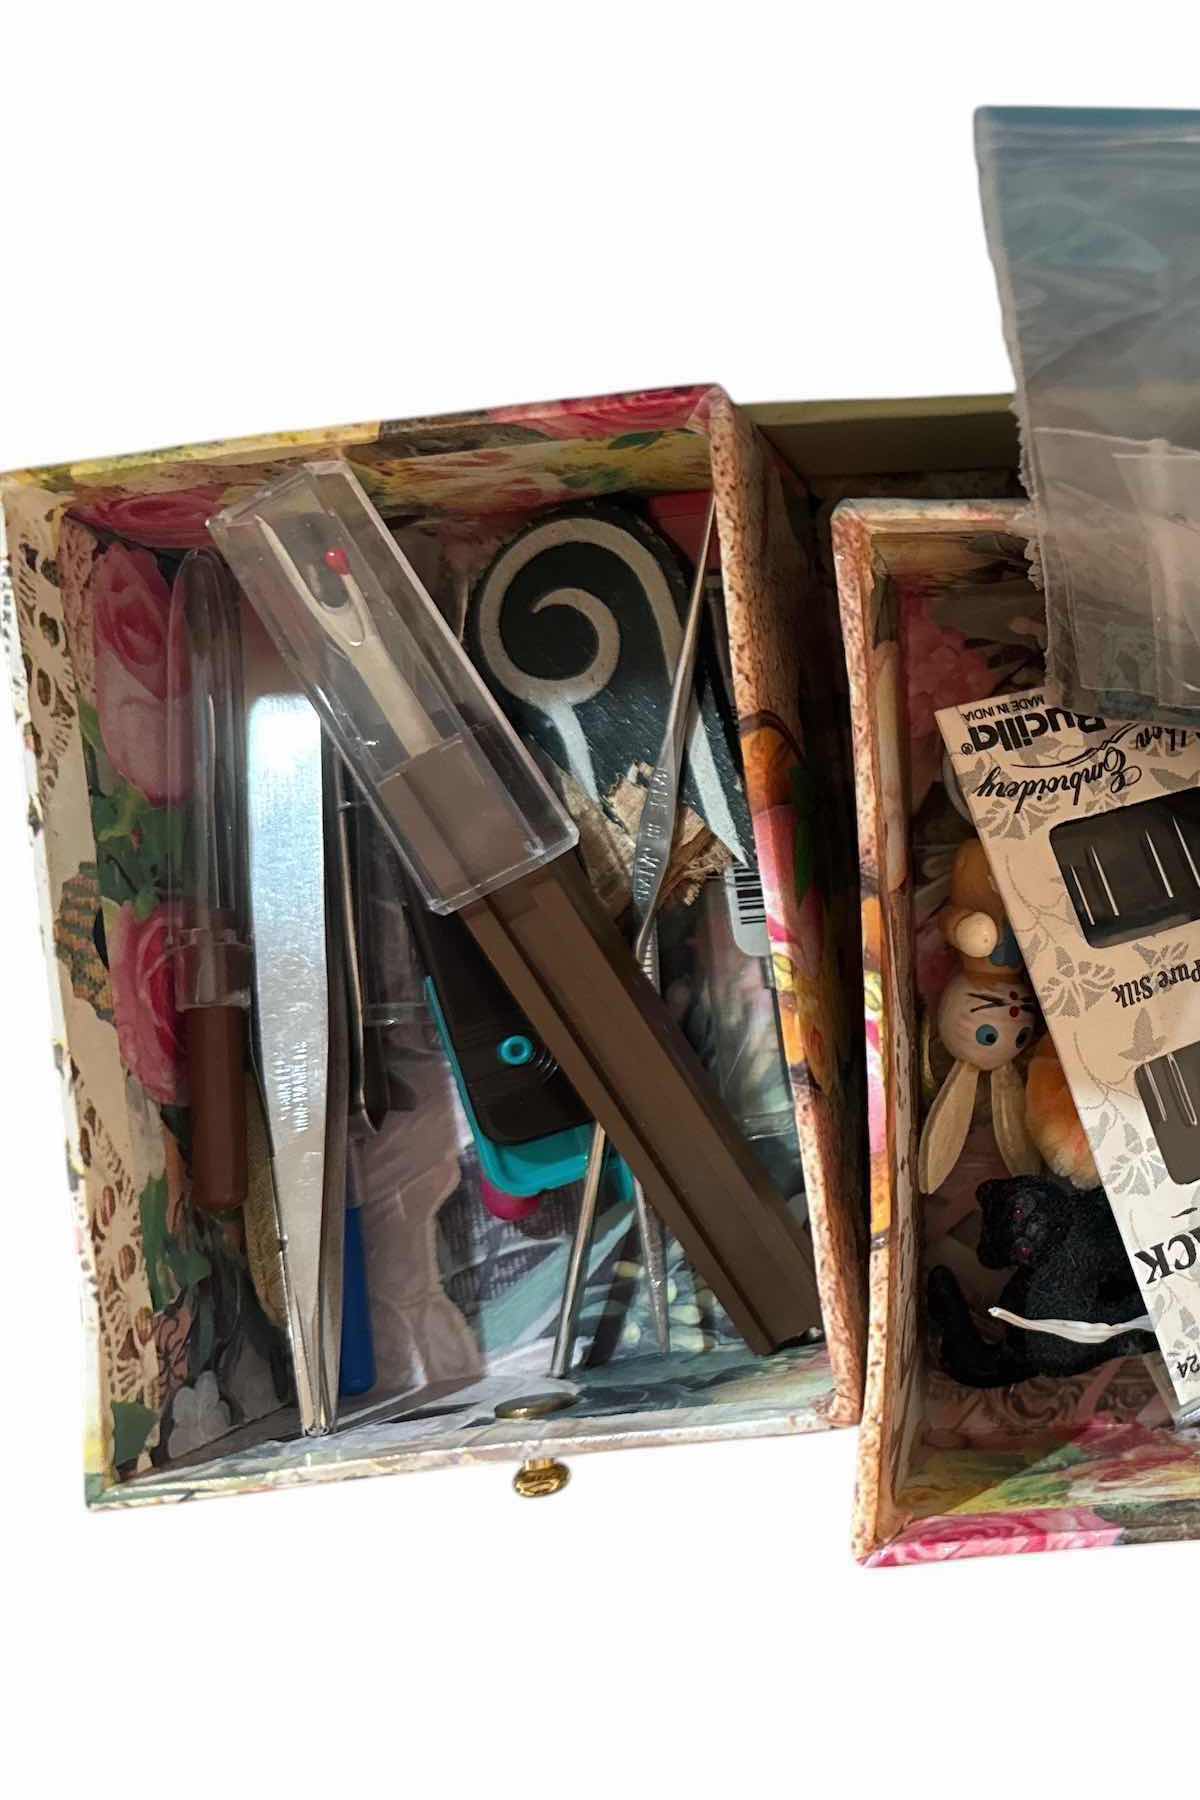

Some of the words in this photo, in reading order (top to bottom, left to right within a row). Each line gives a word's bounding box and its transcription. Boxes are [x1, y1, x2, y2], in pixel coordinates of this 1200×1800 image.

[995, 703, 1011, 715] IN
[1013, 691, 1046, 712] MADE
[962, 707, 994, 722] INDIA
[975, 746, 1142, 814] Embroidery
[1111, 975, 1154, 1008] Silk
